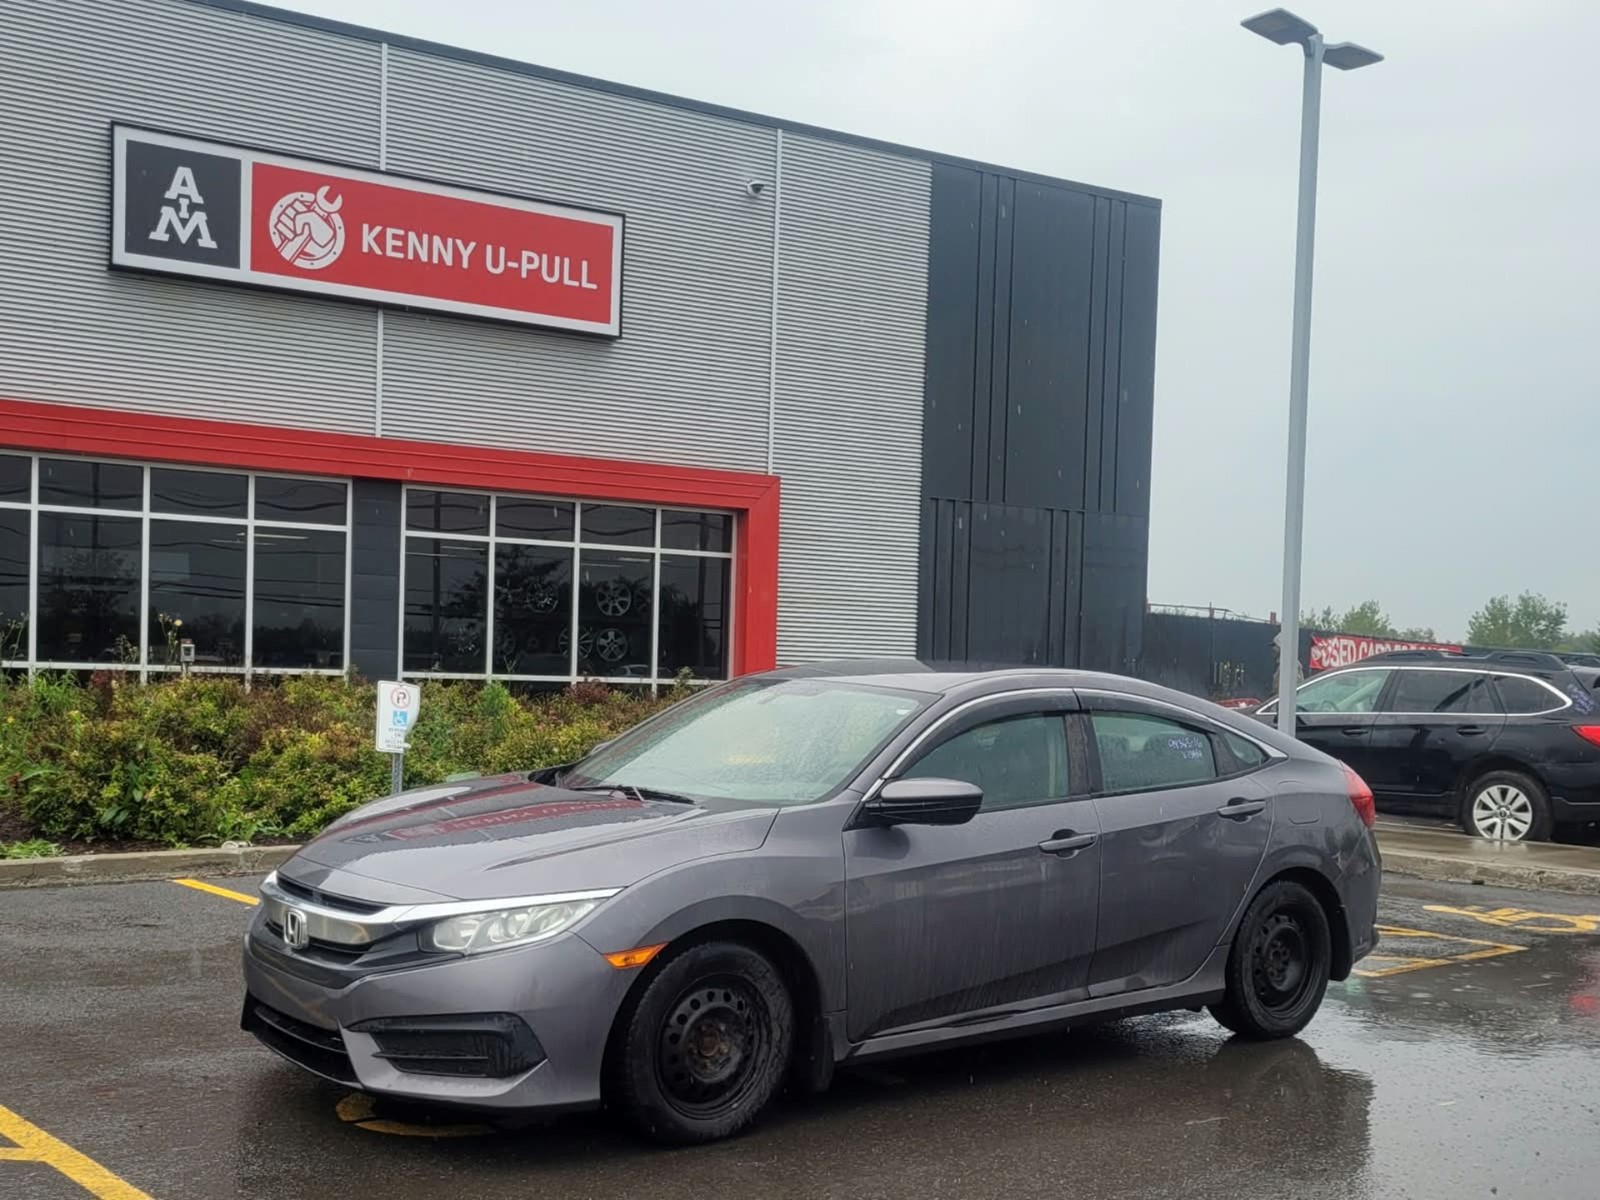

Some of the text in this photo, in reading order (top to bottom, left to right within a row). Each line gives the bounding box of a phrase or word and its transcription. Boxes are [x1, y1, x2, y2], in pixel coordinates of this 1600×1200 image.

[362, 223, 598, 289] KENNY U-PULL
[1322, 637, 1357, 667] USED
